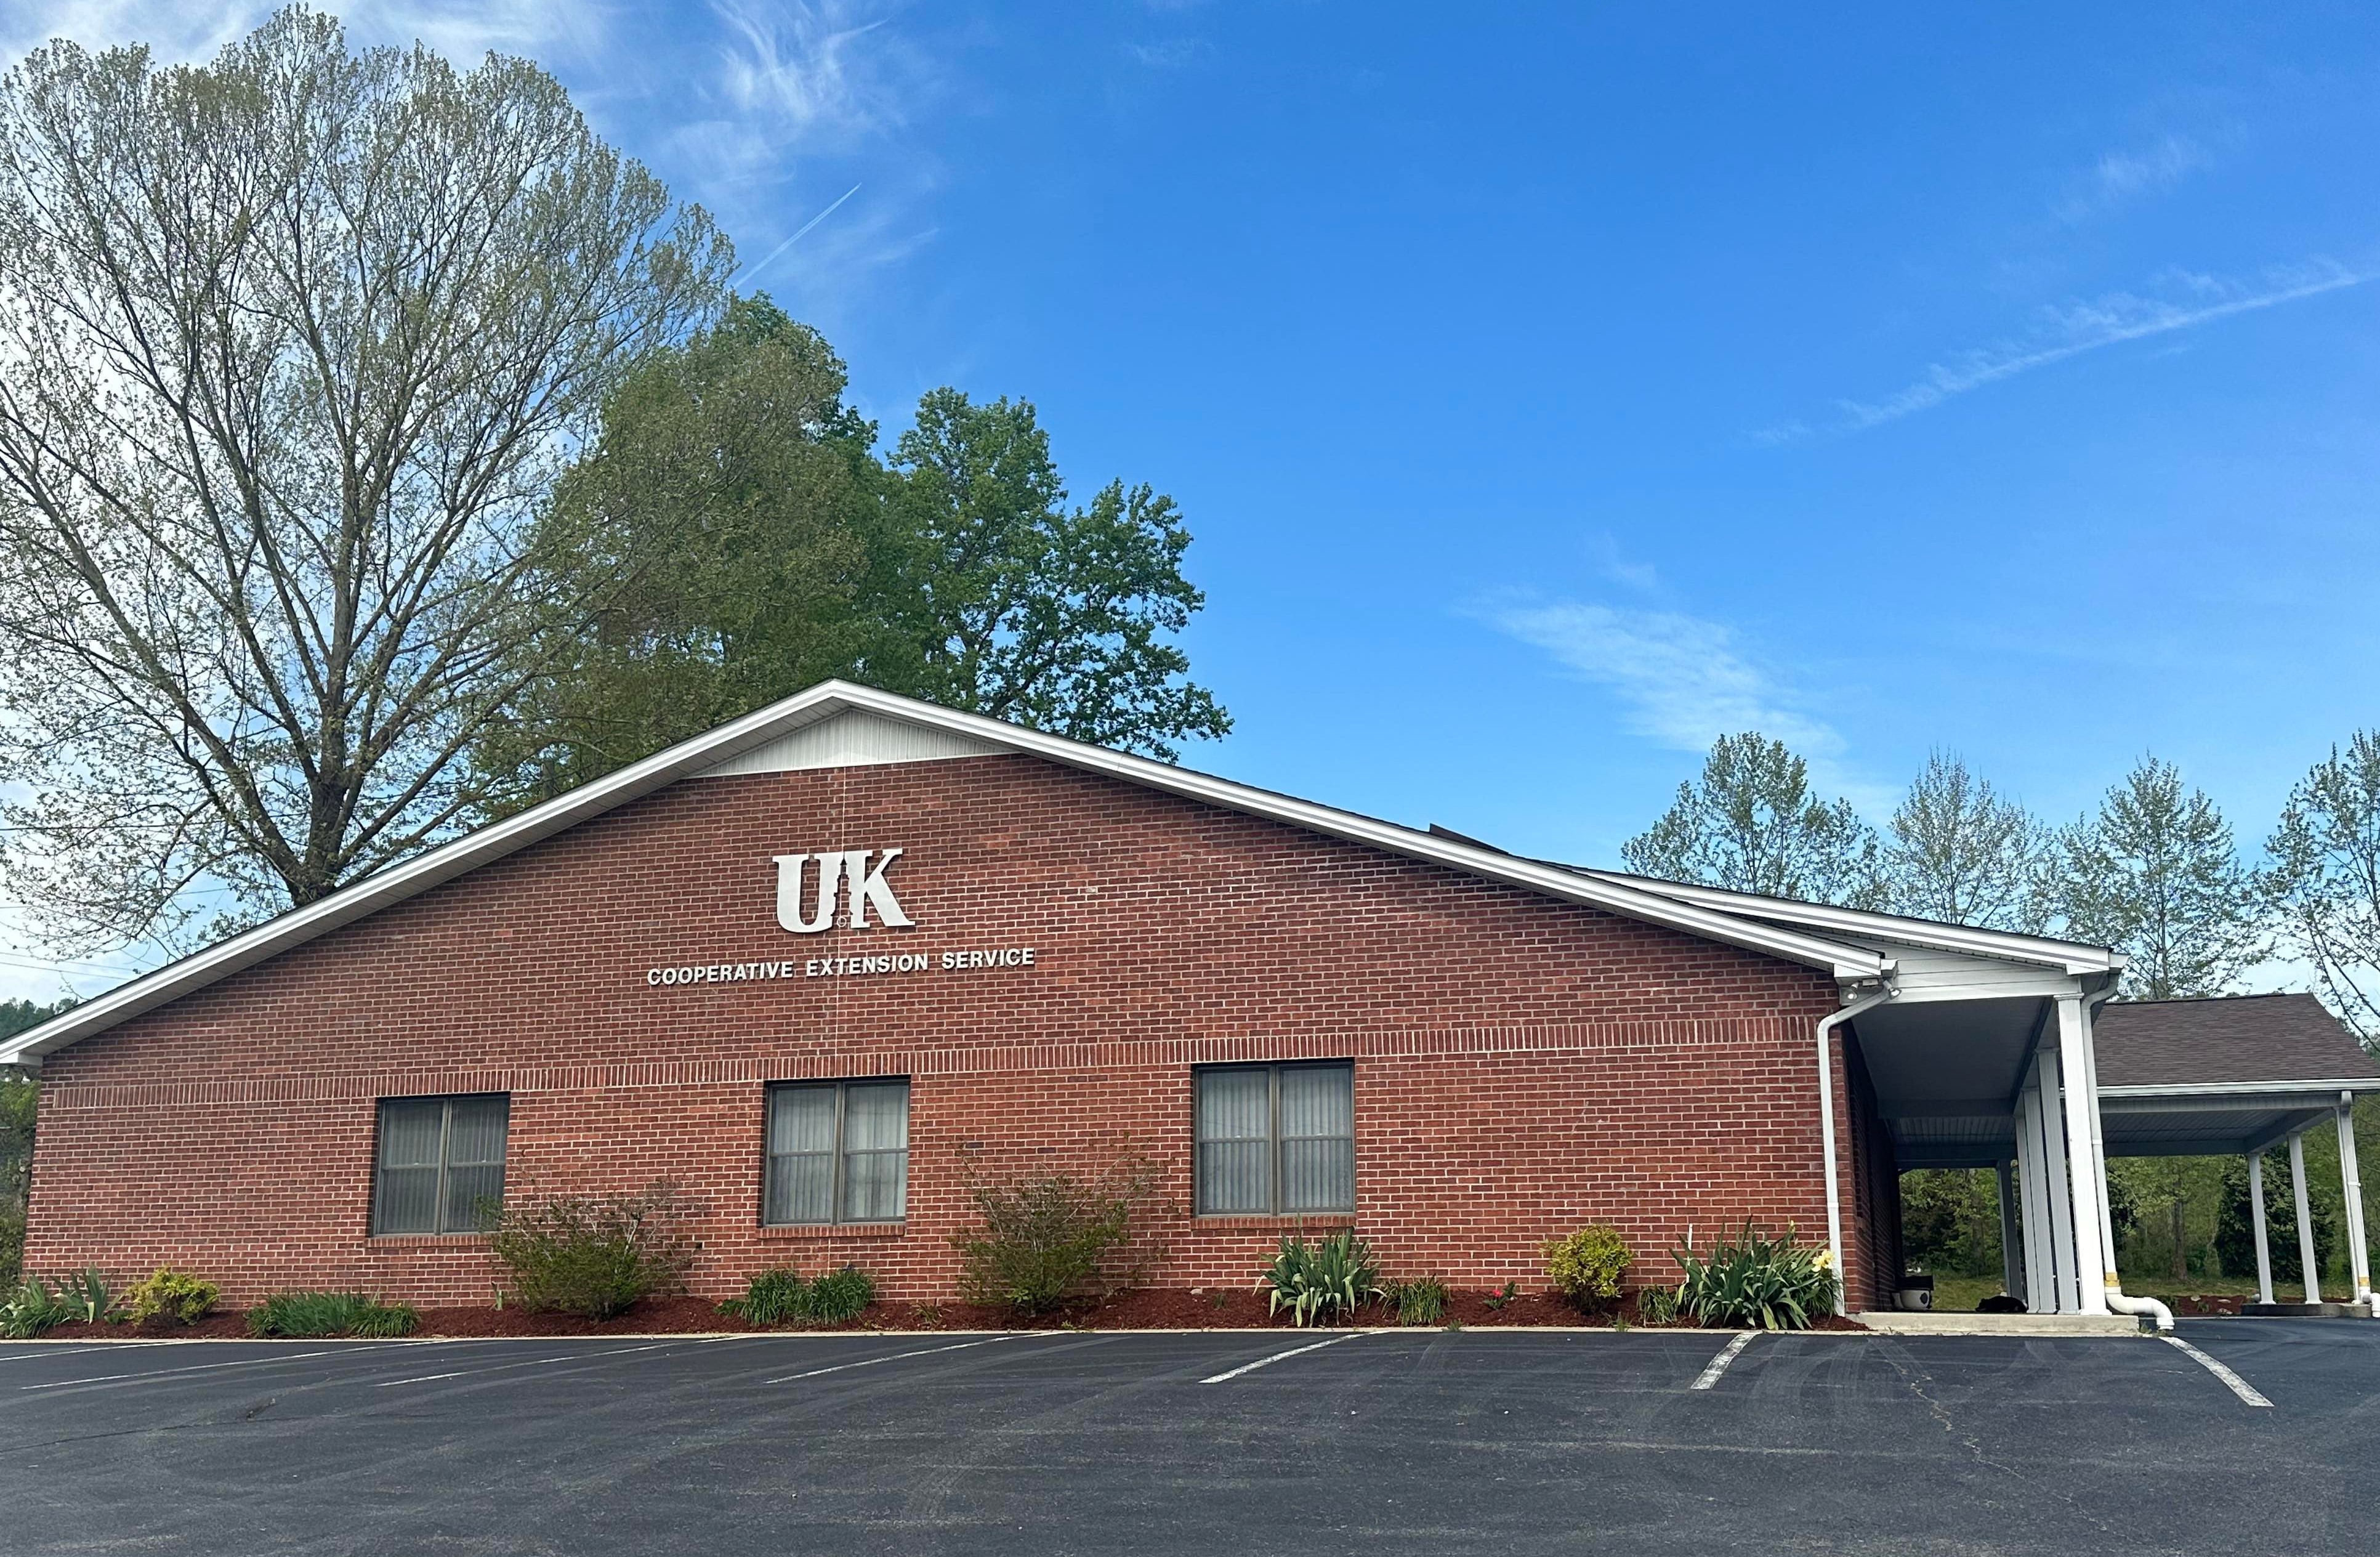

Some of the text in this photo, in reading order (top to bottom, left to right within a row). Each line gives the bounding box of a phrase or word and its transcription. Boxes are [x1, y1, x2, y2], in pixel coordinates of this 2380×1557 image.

[772, 847, 916, 933] UK
[647, 947, 1035, 985] COOPERATIVE EXTENSION SERVICE
